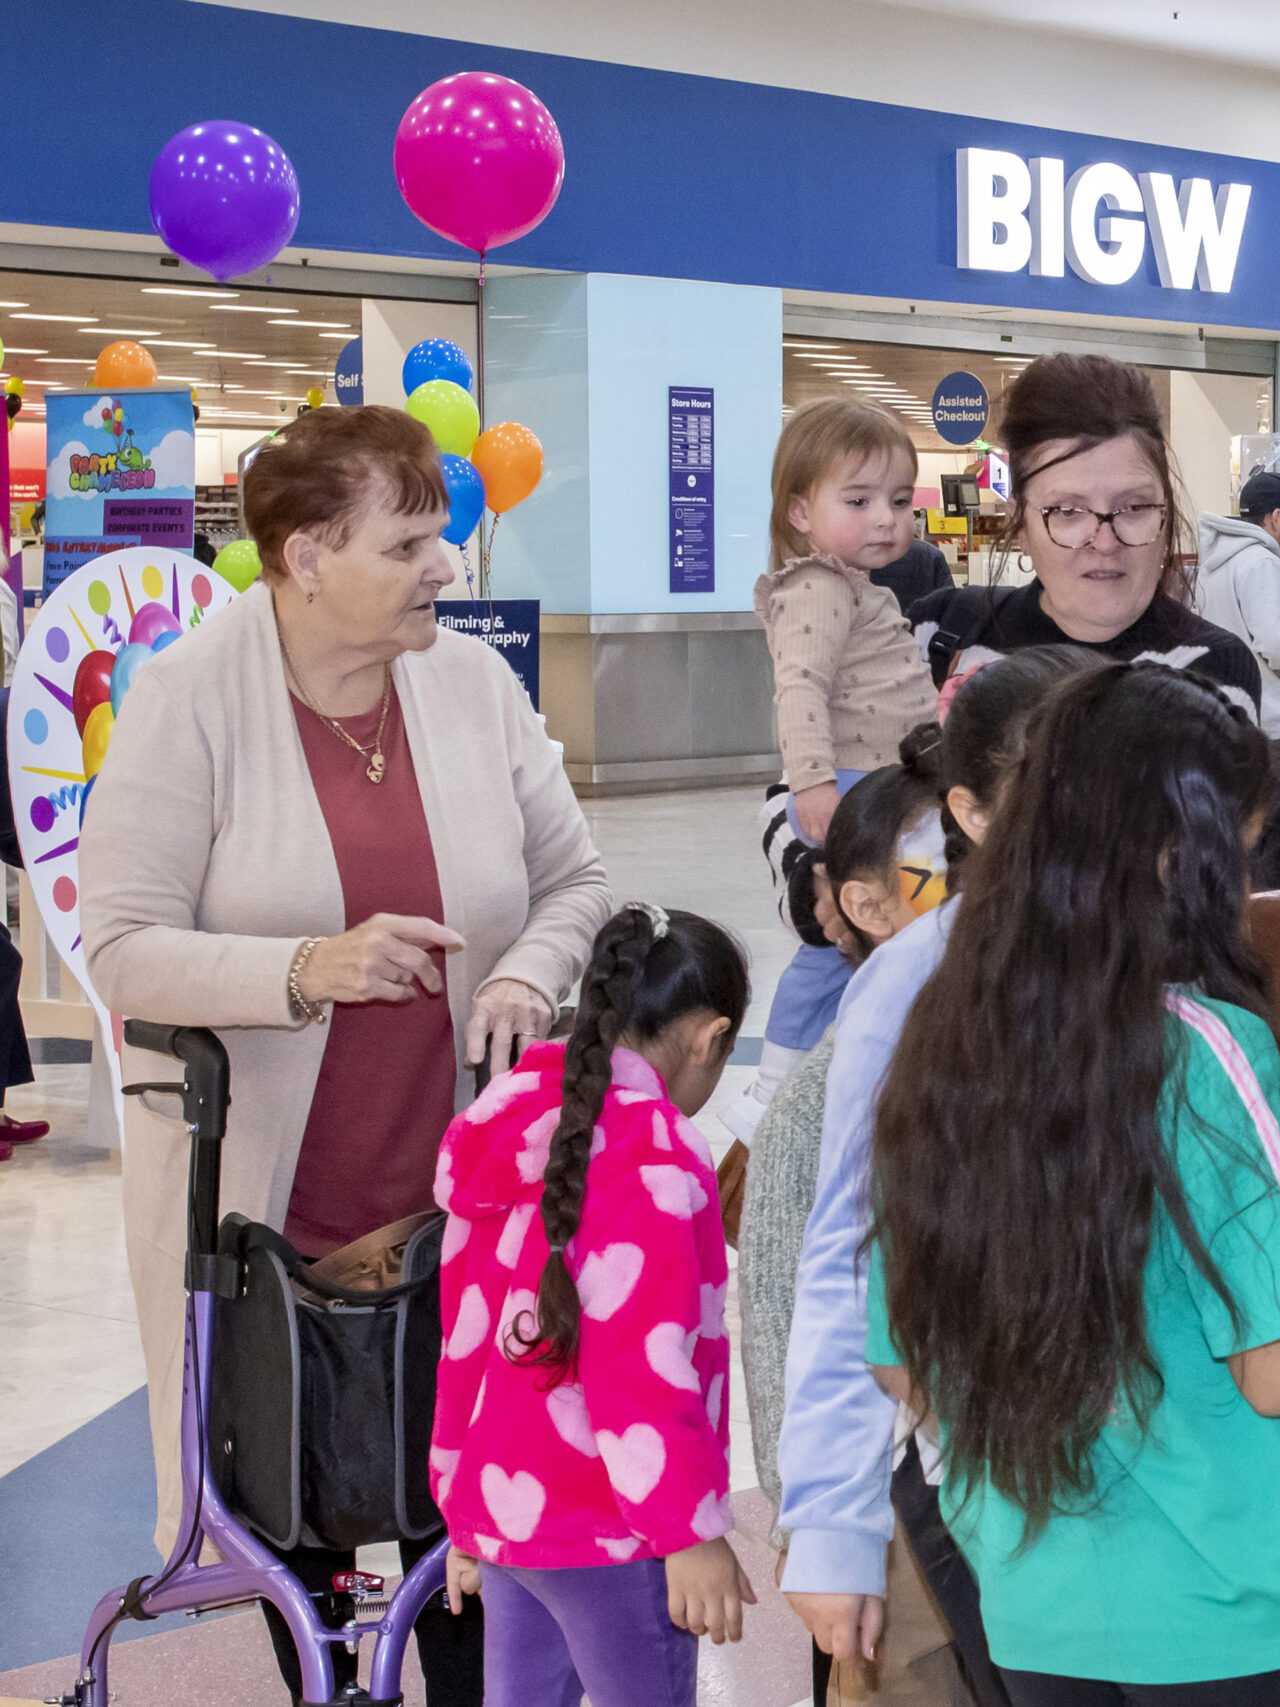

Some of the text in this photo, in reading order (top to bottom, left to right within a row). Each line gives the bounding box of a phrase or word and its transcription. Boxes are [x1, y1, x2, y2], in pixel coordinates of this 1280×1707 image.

[337, 373, 359, 387] Self
[671, 398, 711, 408] Store Hours
[938, 395, 982, 407] Assisted
[935, 410, 985, 421] Checkout
[70, 453, 119, 474] PARTY
[996, 467, 1002, 480] 1
[69, 469, 155, 492] CHAMELEON
[109, 506, 183, 516] BIRTHDAY PARTIES
[152, 524, 185, 533] EVENTS
[438, 615, 505, 632] Filming &
[465, 631, 531, 648] graphy
